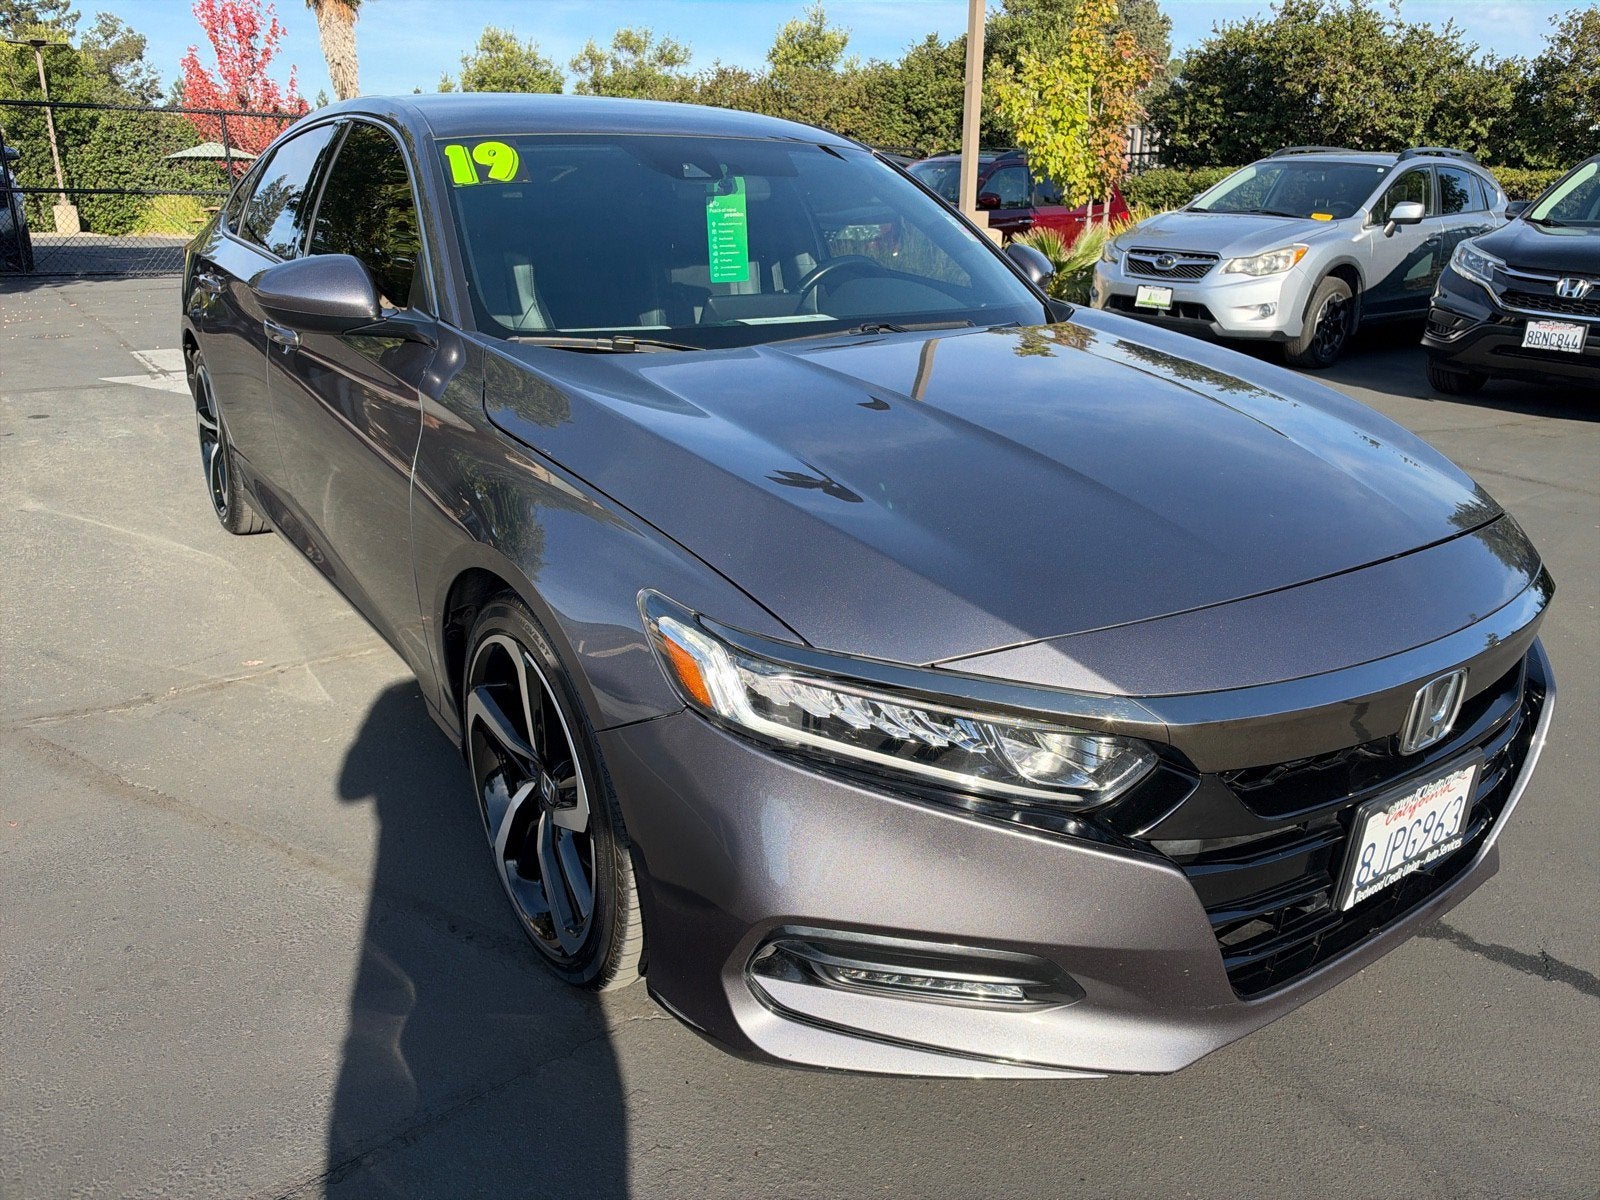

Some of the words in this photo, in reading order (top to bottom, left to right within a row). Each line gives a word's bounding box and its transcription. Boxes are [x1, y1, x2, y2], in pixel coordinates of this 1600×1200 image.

[444, 141, 519, 184] 19
[1526, 331, 1578, 349] 8RNC844
[1356, 796, 1463, 889] 8JPG963
